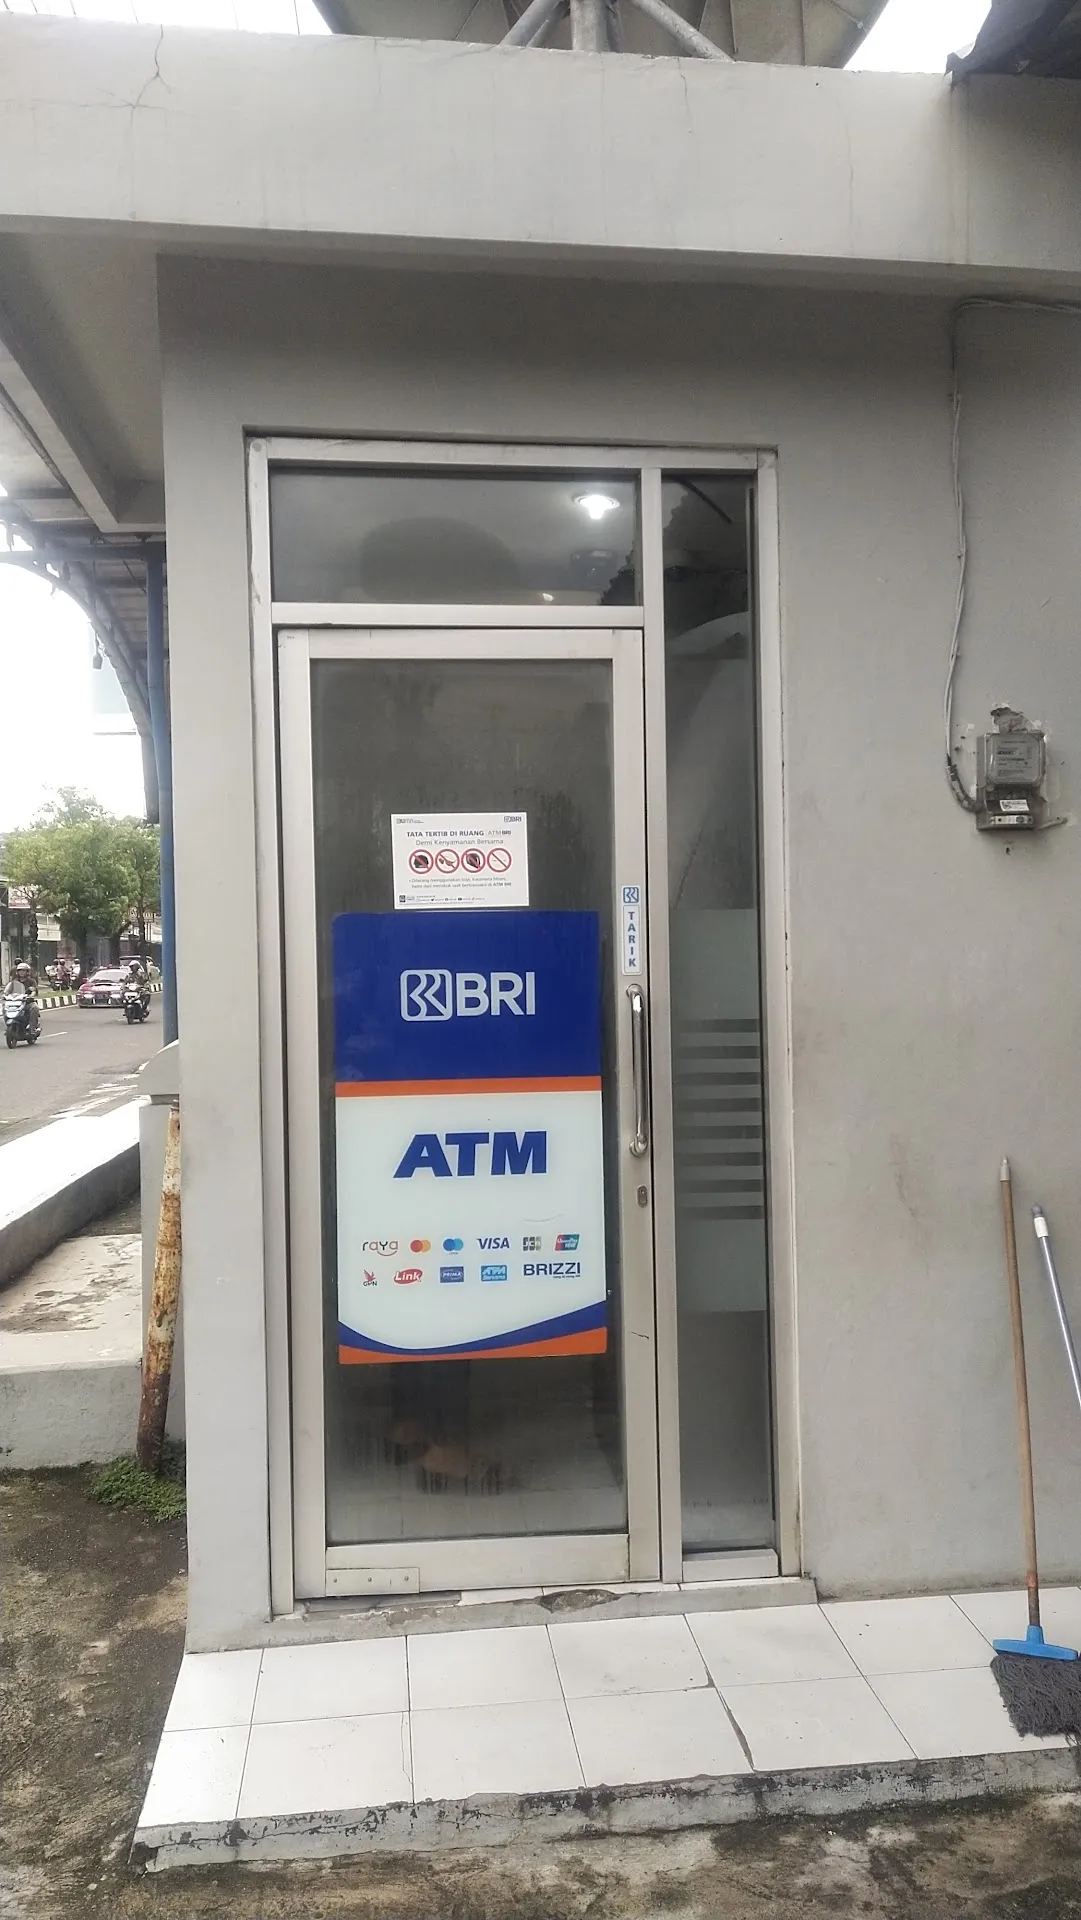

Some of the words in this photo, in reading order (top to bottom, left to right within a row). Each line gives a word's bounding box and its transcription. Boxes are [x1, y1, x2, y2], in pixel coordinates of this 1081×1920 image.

[434, 839, 475, 847] Kenyamanan
[627, 911, 636, 967] TARIK
[456, 971, 536, 1017] BRI
[392, 1131, 547, 1178] ATM
[362, 1240, 398, 1252] raya
[476, 1237, 510, 1250] VISA
[523, 1262, 580, 1276] BRIZZI
[395, 1270, 421, 1283] Link
